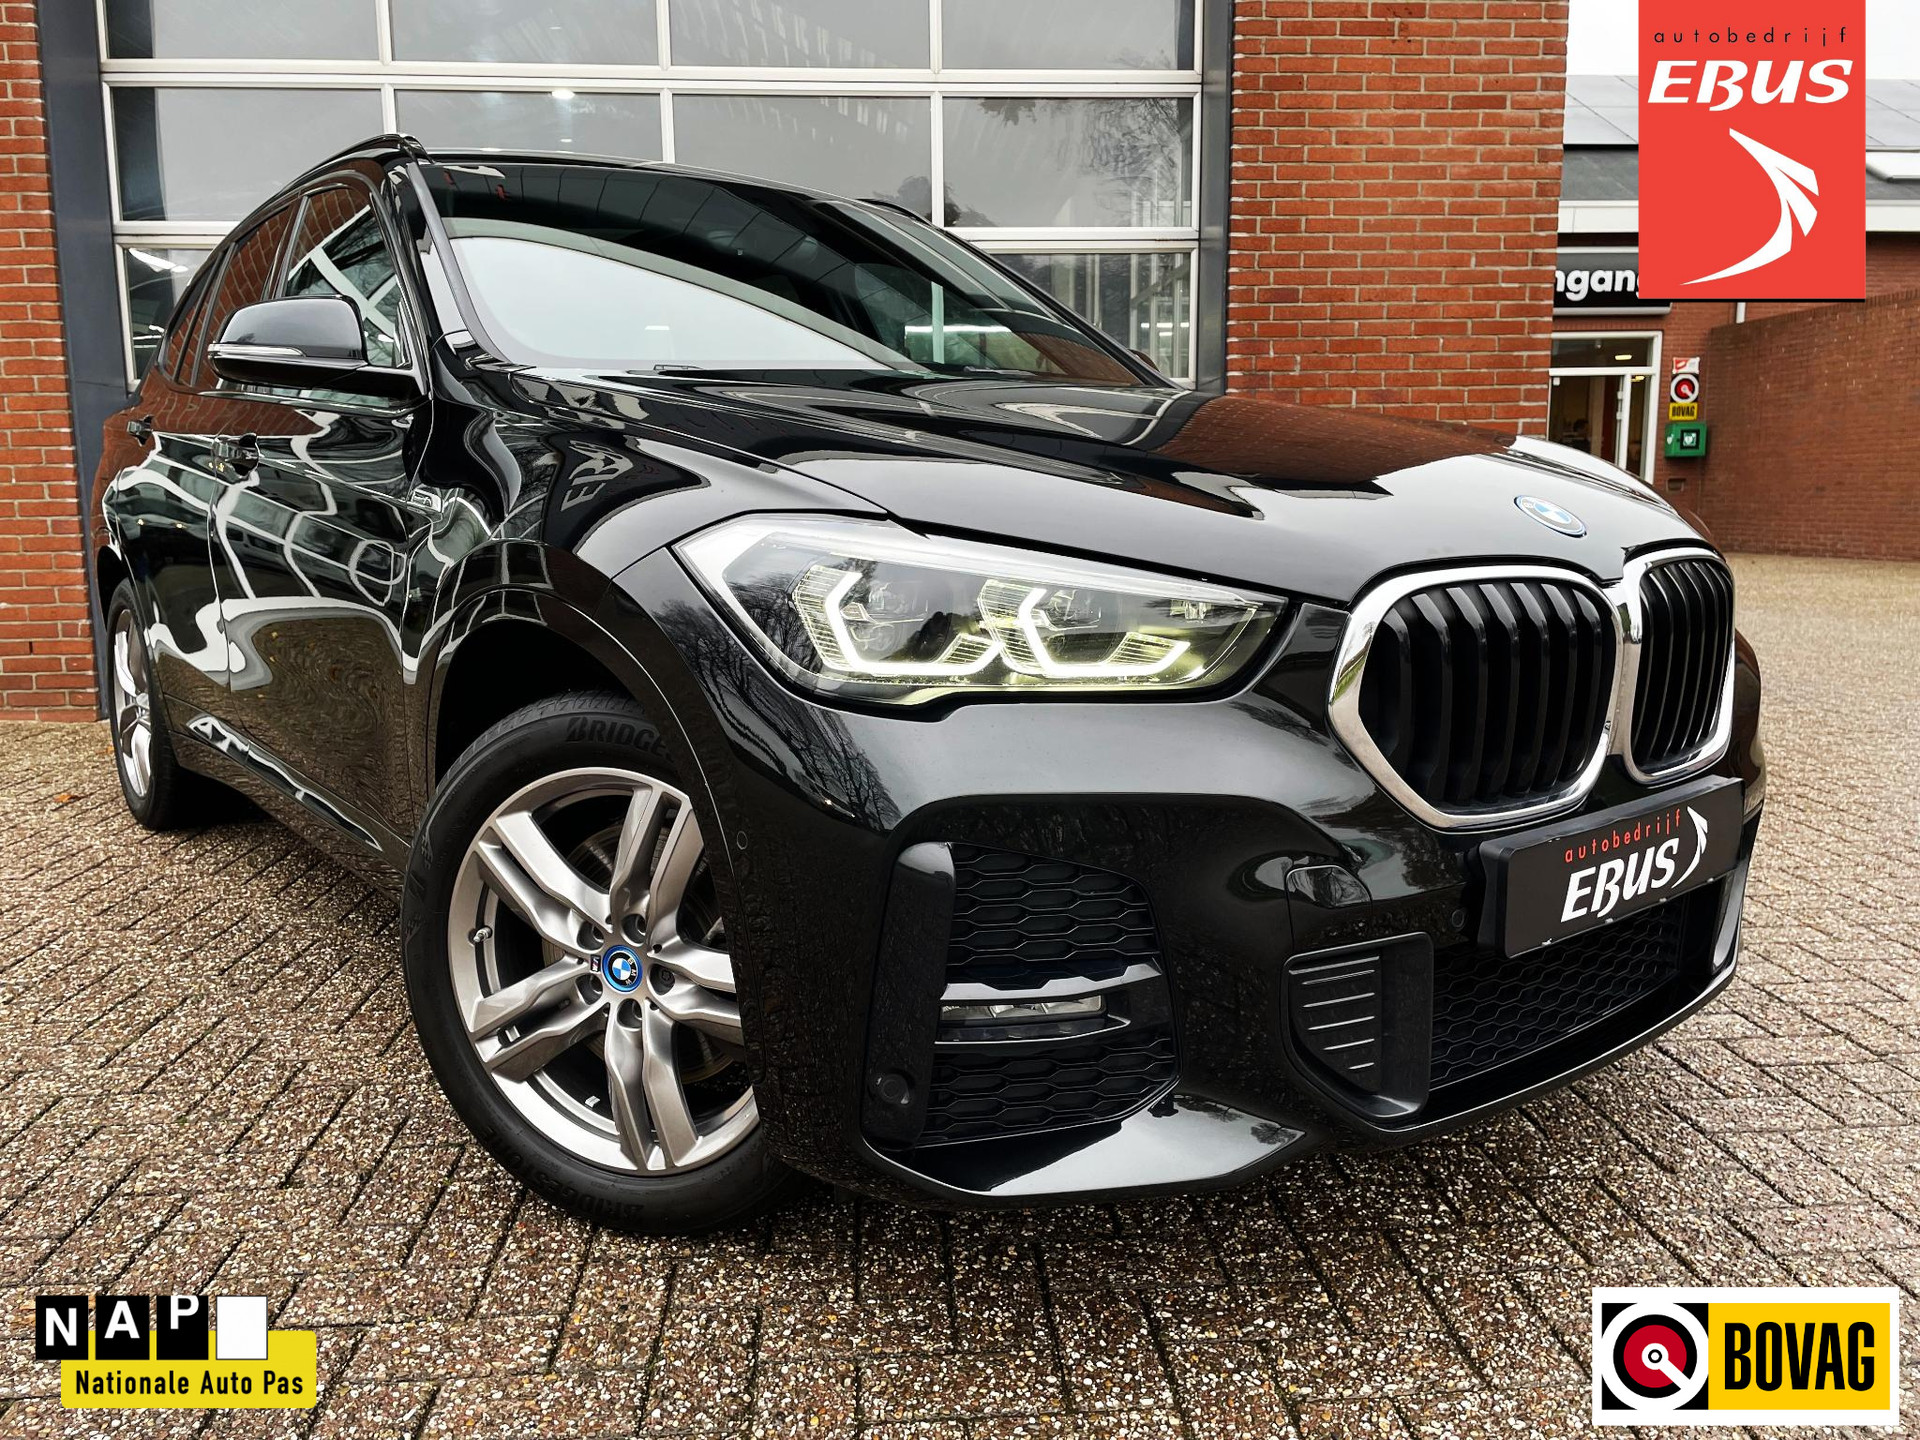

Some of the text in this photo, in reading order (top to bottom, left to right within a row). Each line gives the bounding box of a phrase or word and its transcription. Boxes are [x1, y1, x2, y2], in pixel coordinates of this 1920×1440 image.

[1555, 269, 1639, 301] ngan
[1671, 405, 1695, 417] BOVAG
[1564, 809, 1681, 863] autobedrijf
[1561, 837, 1680, 923] EBUS
